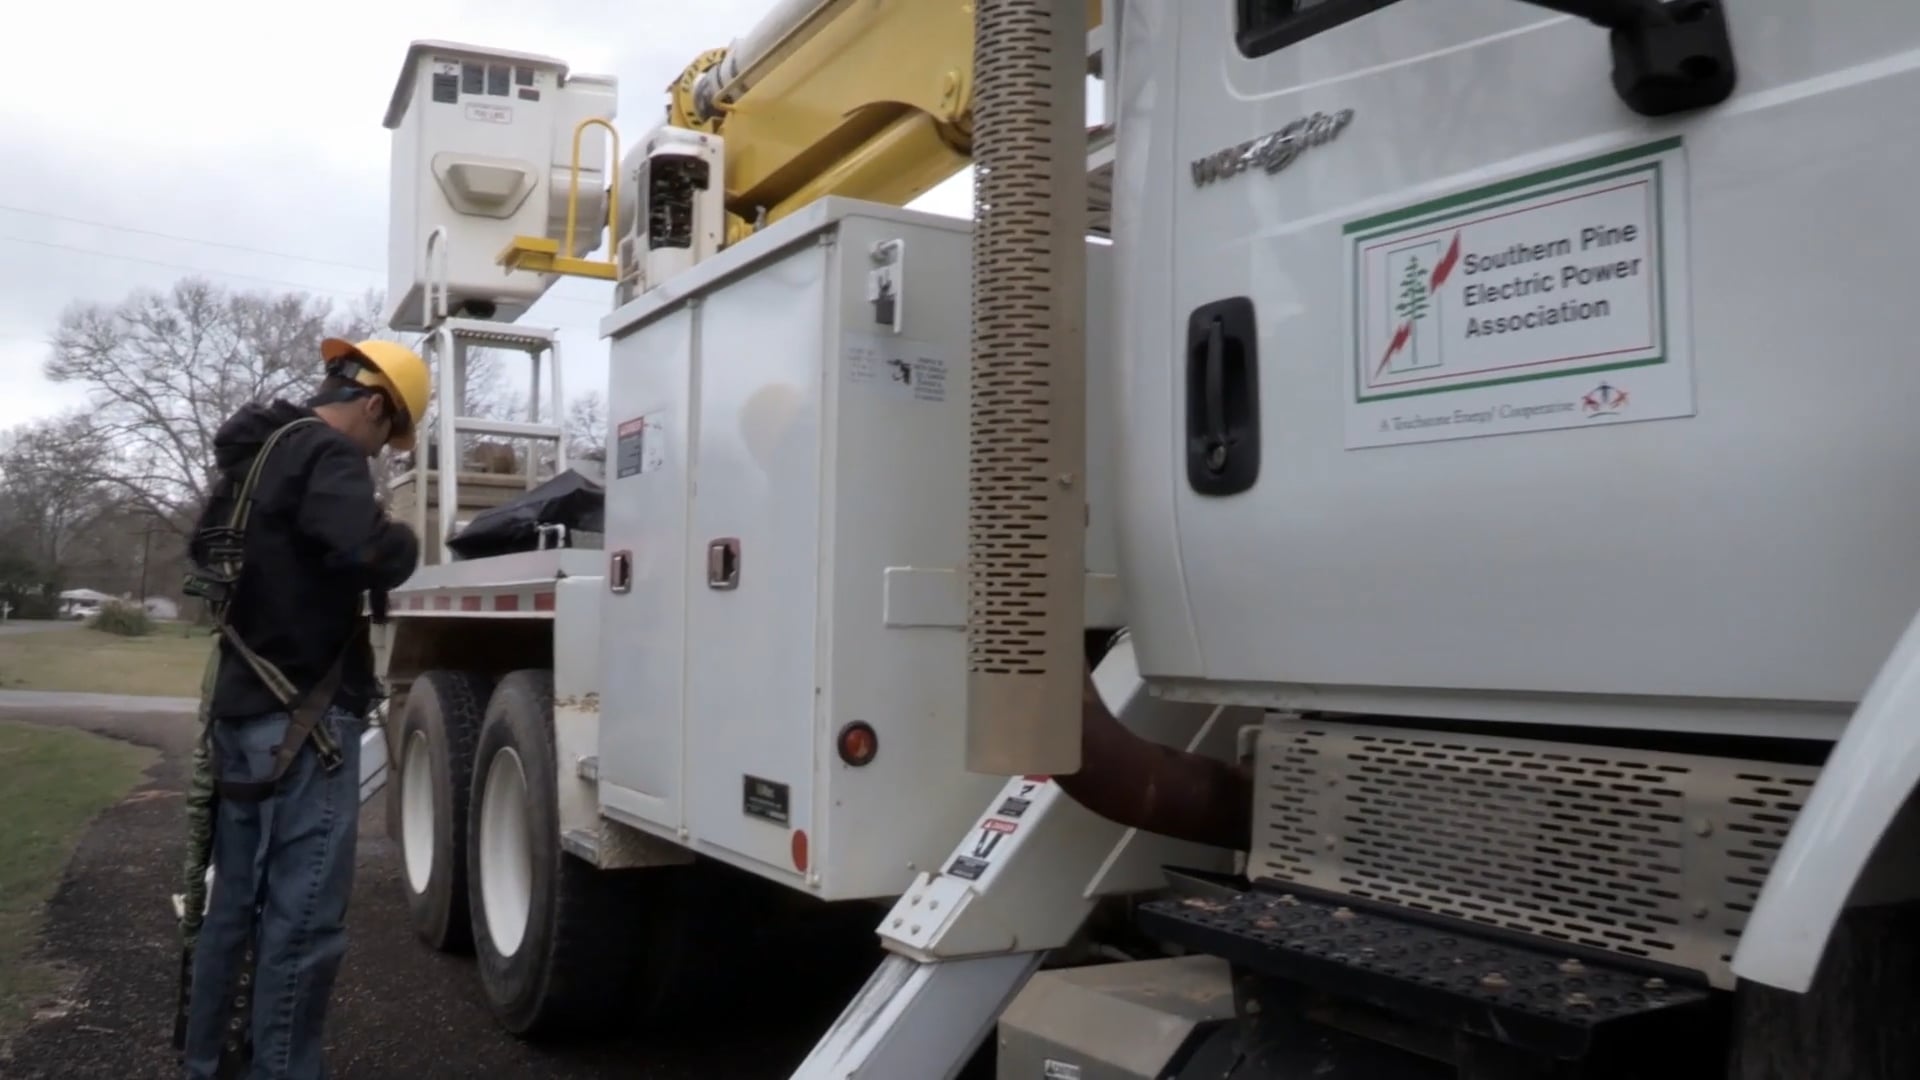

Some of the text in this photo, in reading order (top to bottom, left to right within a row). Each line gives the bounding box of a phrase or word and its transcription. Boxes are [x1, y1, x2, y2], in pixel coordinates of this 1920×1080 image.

[1463, 223, 1638, 276] Southern Pine
[1463, 258, 1642, 307] Electric Power
[1465, 298, 1611, 339] Association
